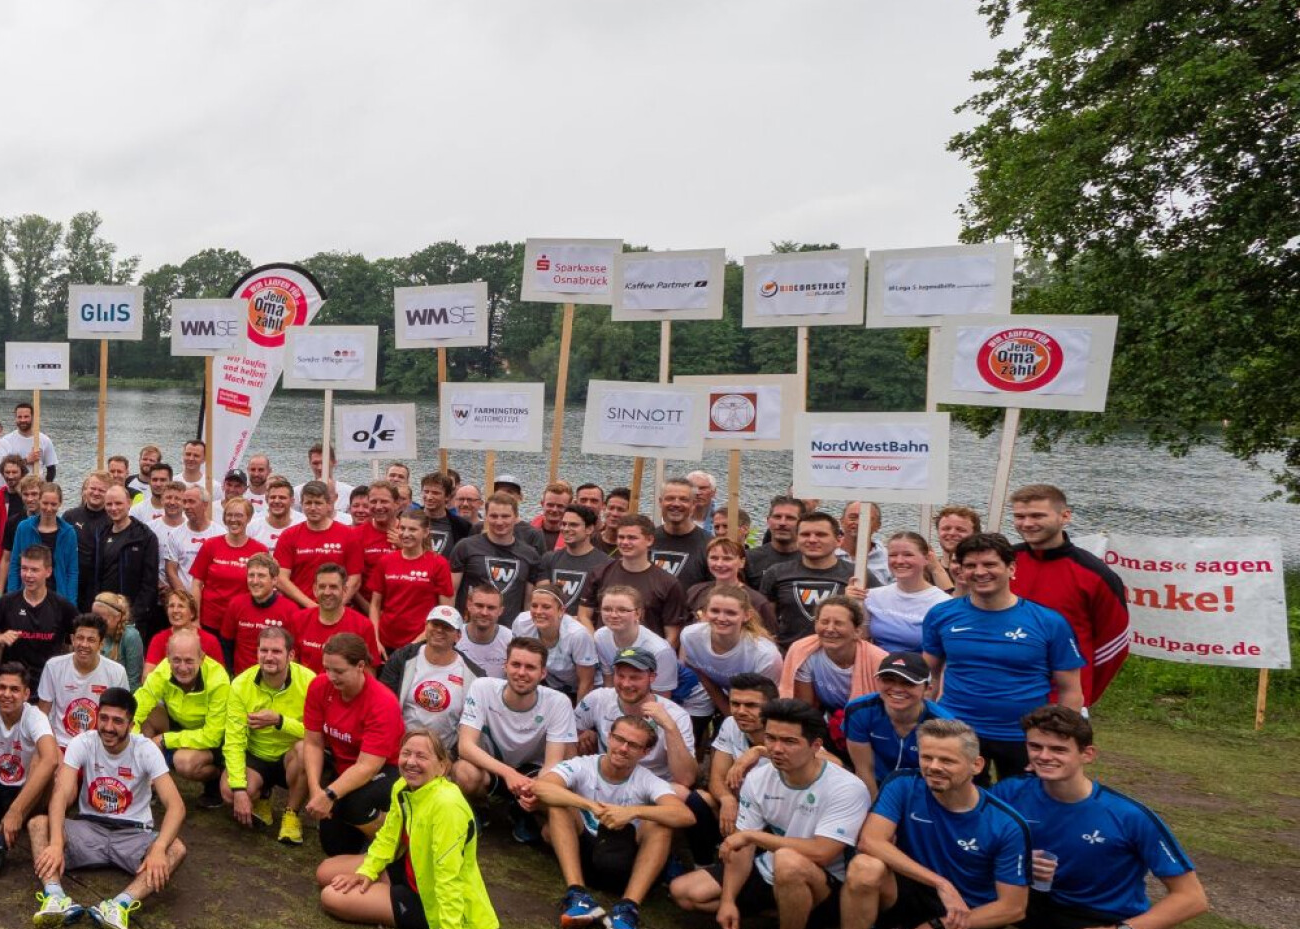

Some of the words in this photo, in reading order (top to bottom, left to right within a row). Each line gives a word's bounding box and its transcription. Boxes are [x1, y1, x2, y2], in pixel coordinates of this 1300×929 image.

[555, 263, 607, 273] Sparkasse
[553, 275, 608, 286] Osnabrück
[624, 282, 655, 290] Kaffee
[656, 281, 692, 289] Partner
[263, 290, 288, 305] Jede
[254, 297, 285, 317] Oma
[1007, 343, 1036, 352] Jede
[997, 350, 1034, 363] Oma
[223, 364, 239, 372] und
[243, 357, 266, 369] laufen
[224, 374, 246, 384] Mach
[607, 408, 684, 423] SINNOTT
[811, 440, 929, 452] NordWestBahn
[1195, 560, 1273, 576] sagen
